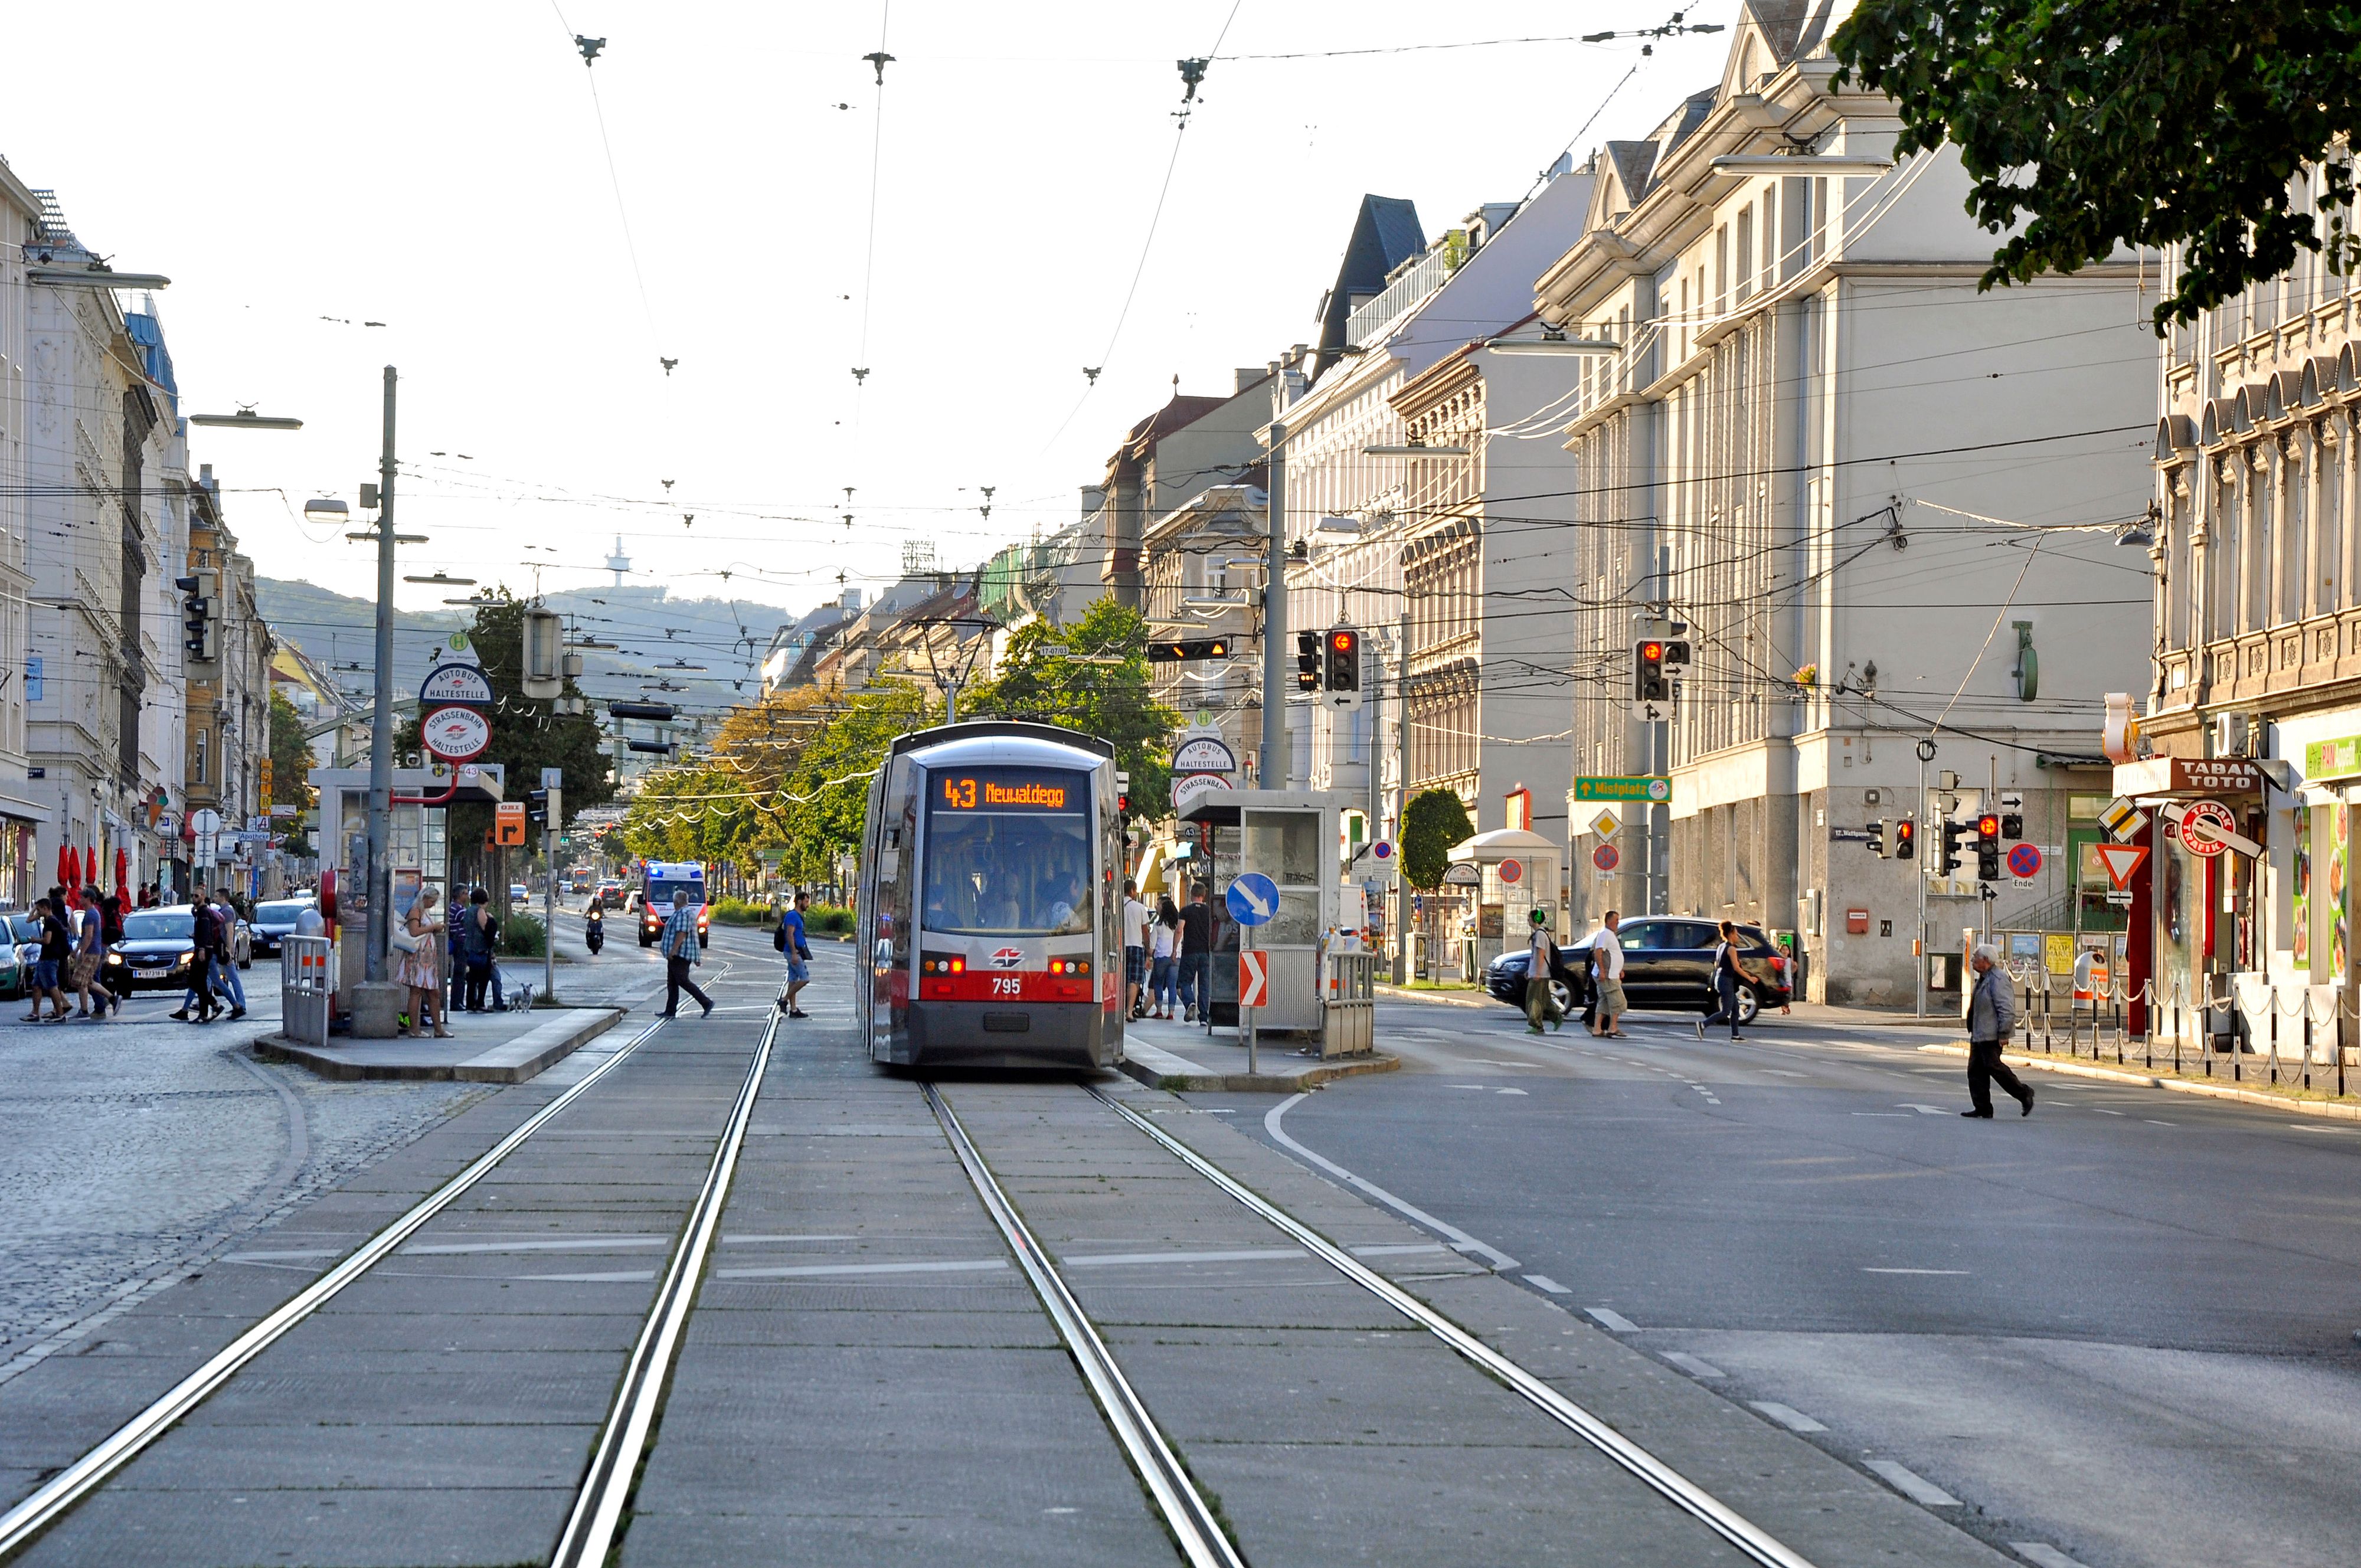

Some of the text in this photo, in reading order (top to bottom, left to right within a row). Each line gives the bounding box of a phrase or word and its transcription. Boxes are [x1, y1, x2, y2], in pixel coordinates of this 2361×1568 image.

[454, 637, 463, 647] H
[439, 670, 478, 683] AUTOBUS
[430, 690, 484, 698] HALTESTELLE
[429, 711, 484, 729] STRASSENBAHN
[1200, 713, 1208, 724] H
[431, 738, 482, 754] HALTESTELLE
[1188, 743, 1222, 755] AUTOBUS
[2180, 762, 2259, 775] TABAK
[1180, 778, 1226, 795] STRASSENBAH
[2187, 775, 2250, 788] TOTO
[946, 779, 1064, 807] 43 Neuwaldegg
[1595, 783, 1647, 796] Mistplatz
[2191, 804, 2232, 827] TABAK
[2183, 824, 2221, 852] TRAFIK
[2015, 879, 2032, 888] Ende
[993, 978, 1021, 994] 795
